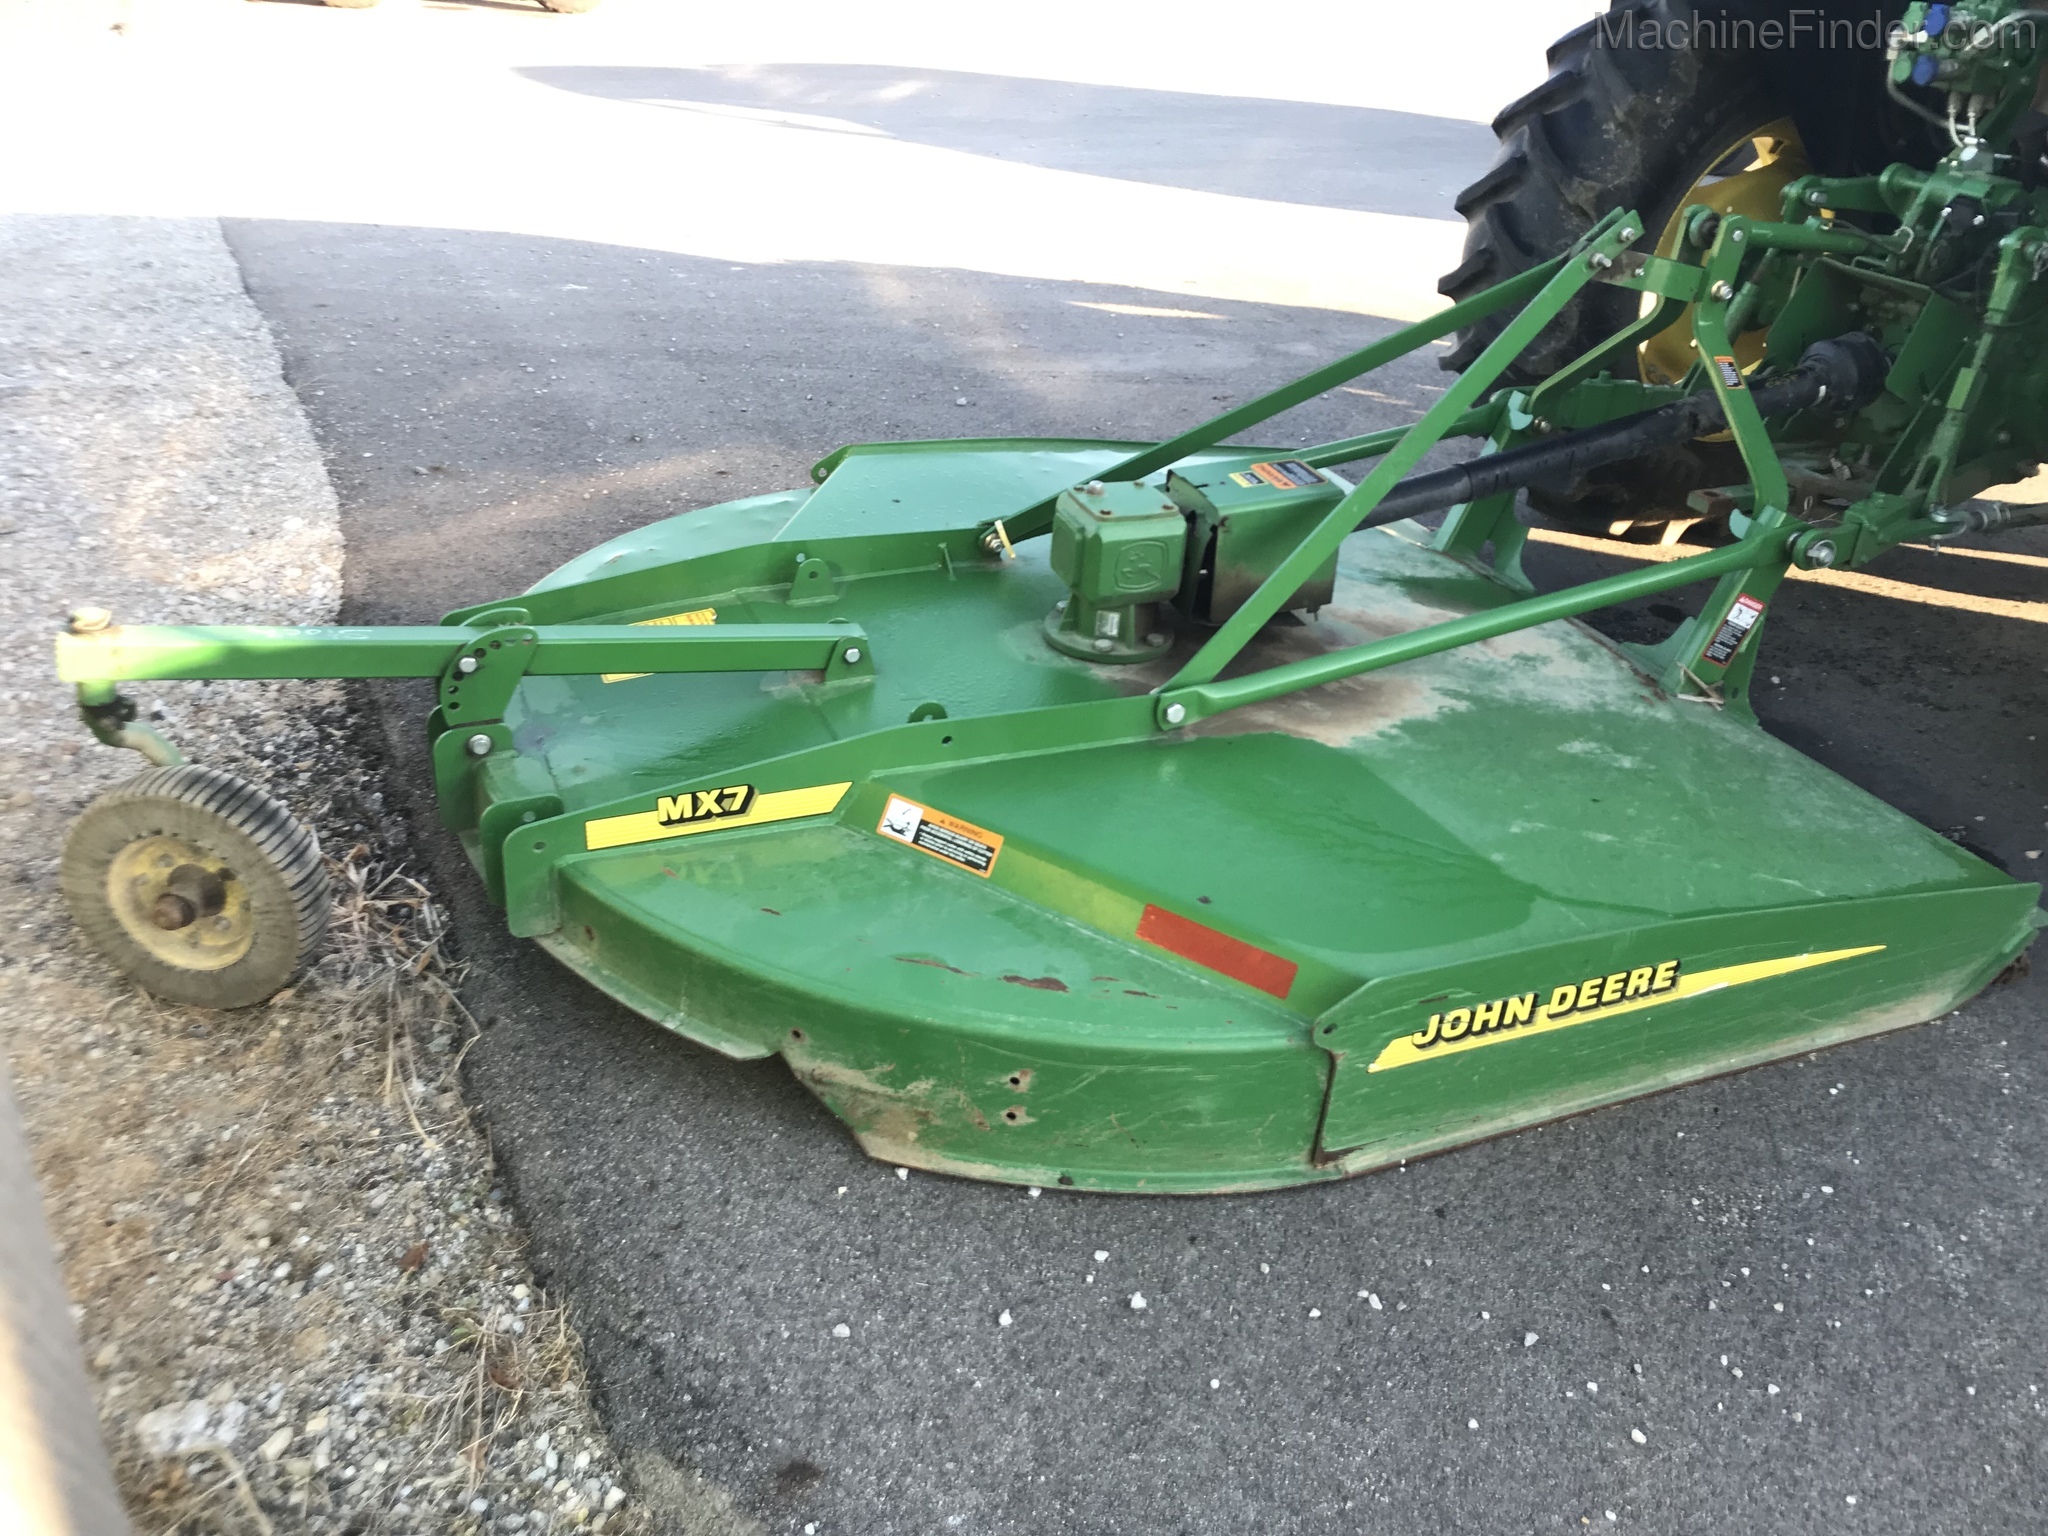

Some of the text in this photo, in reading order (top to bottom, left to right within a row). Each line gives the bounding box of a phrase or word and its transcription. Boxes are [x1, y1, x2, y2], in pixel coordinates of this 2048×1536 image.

[656, 784, 757, 826] MX7
[1412, 958, 1681, 1048] JOHN DEERE
